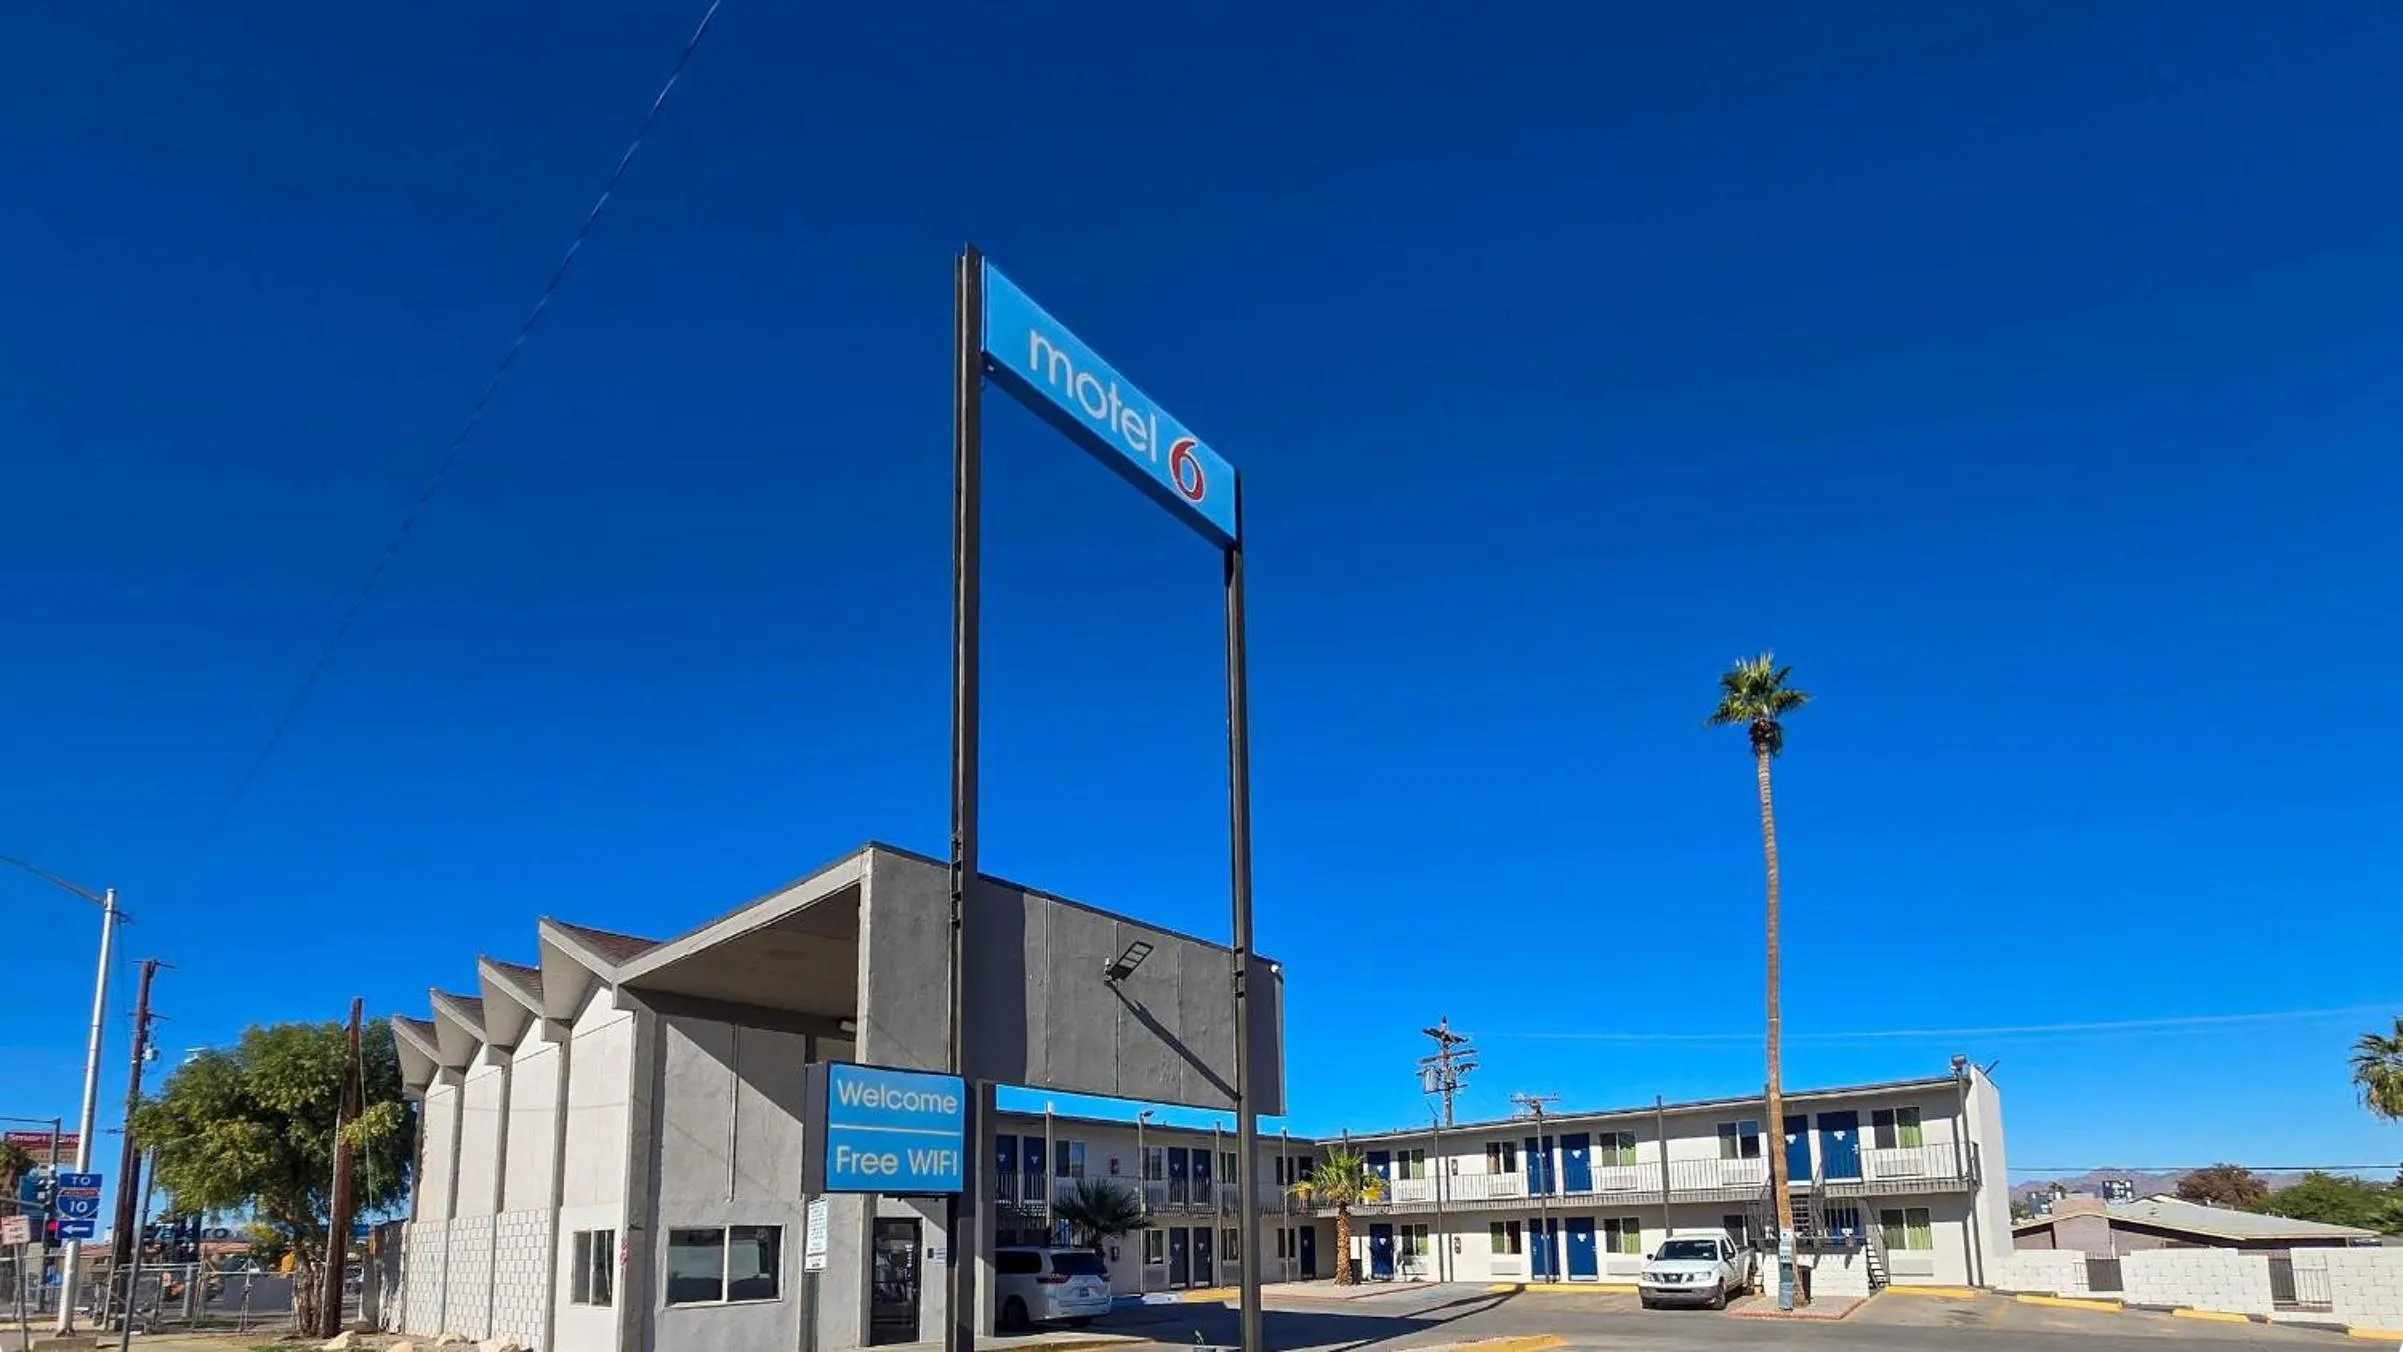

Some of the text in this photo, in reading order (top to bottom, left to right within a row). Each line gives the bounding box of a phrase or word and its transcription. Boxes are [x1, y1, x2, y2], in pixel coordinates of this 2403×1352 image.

[1028, 329, 1206, 503] motel 6
[837, 1079, 958, 1114] Welcome
[836, 1145, 958, 1177] Free WIFI
[72, 1176, 91, 1186] TO
[70, 1200, 88, 1213] 10
